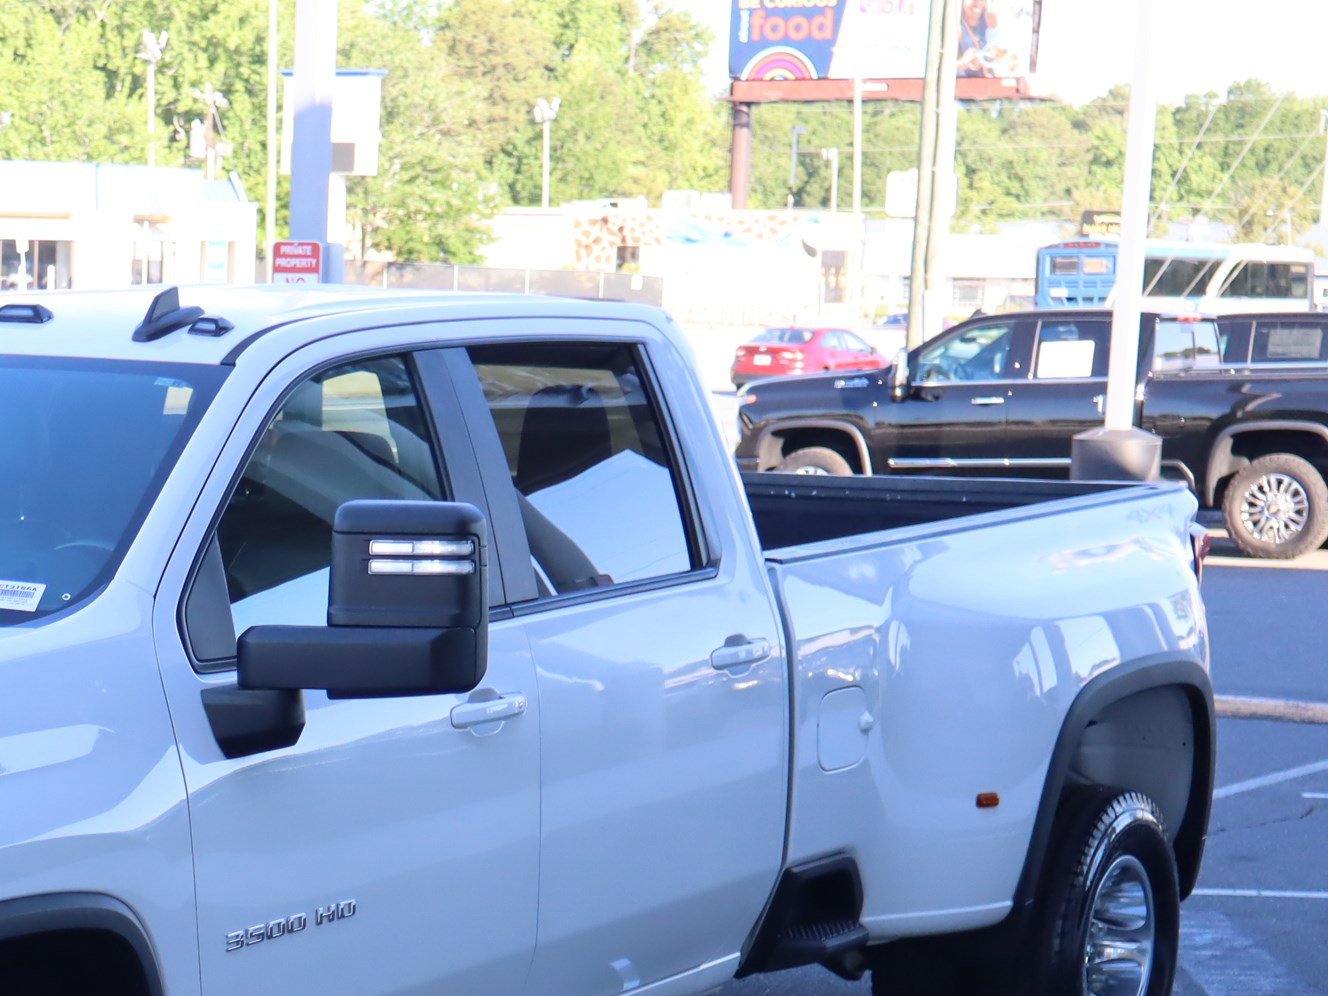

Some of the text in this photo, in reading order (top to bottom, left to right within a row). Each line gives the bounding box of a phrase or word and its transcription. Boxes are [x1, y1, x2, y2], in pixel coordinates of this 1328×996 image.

[750, 8, 835, 42] food
[280, 245, 313, 256] PRIVATE
[274, 257, 318, 268] PROPERTY
[225, 898, 357, 953] 3500 HD
